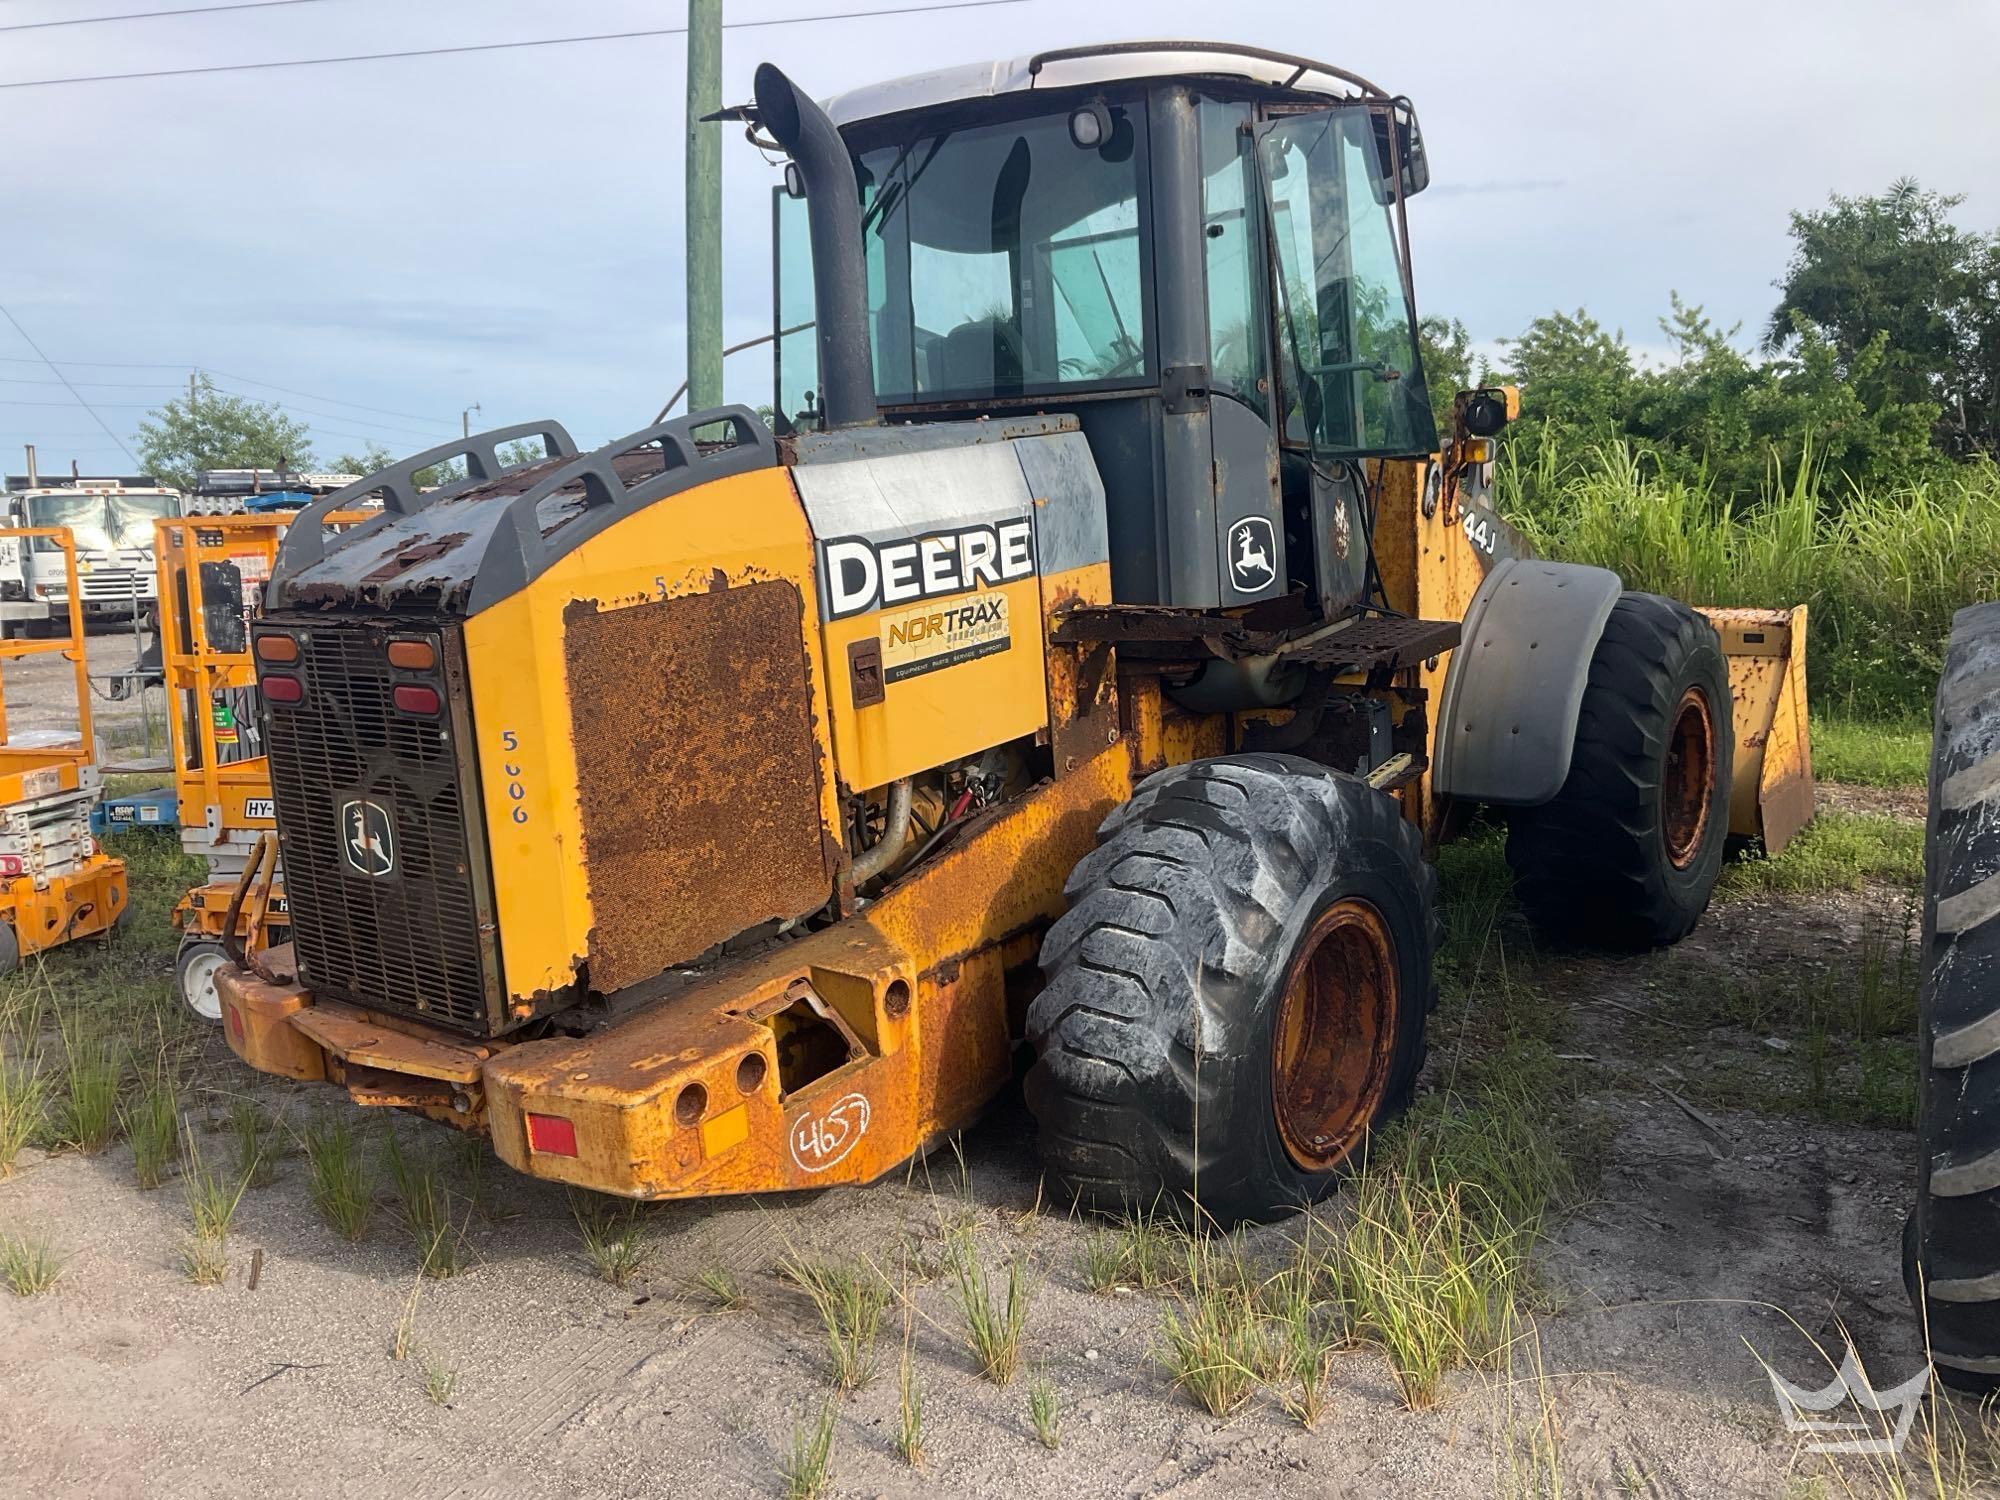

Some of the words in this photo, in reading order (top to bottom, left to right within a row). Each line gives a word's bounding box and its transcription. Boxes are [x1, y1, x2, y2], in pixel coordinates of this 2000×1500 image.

[1458, 505, 1496, 555] 44J
[826, 522, 1033, 615] DEERE
[888, 598, 1003, 648] NORTRAX
[896, 663, 929, 678] EQUIPMENT
[932, 657, 949, 667] PARTS
[953, 651, 975, 662] SERVICE
[978, 643, 1003, 655] SUPPORT
[248, 802, 276, 816] HY-
